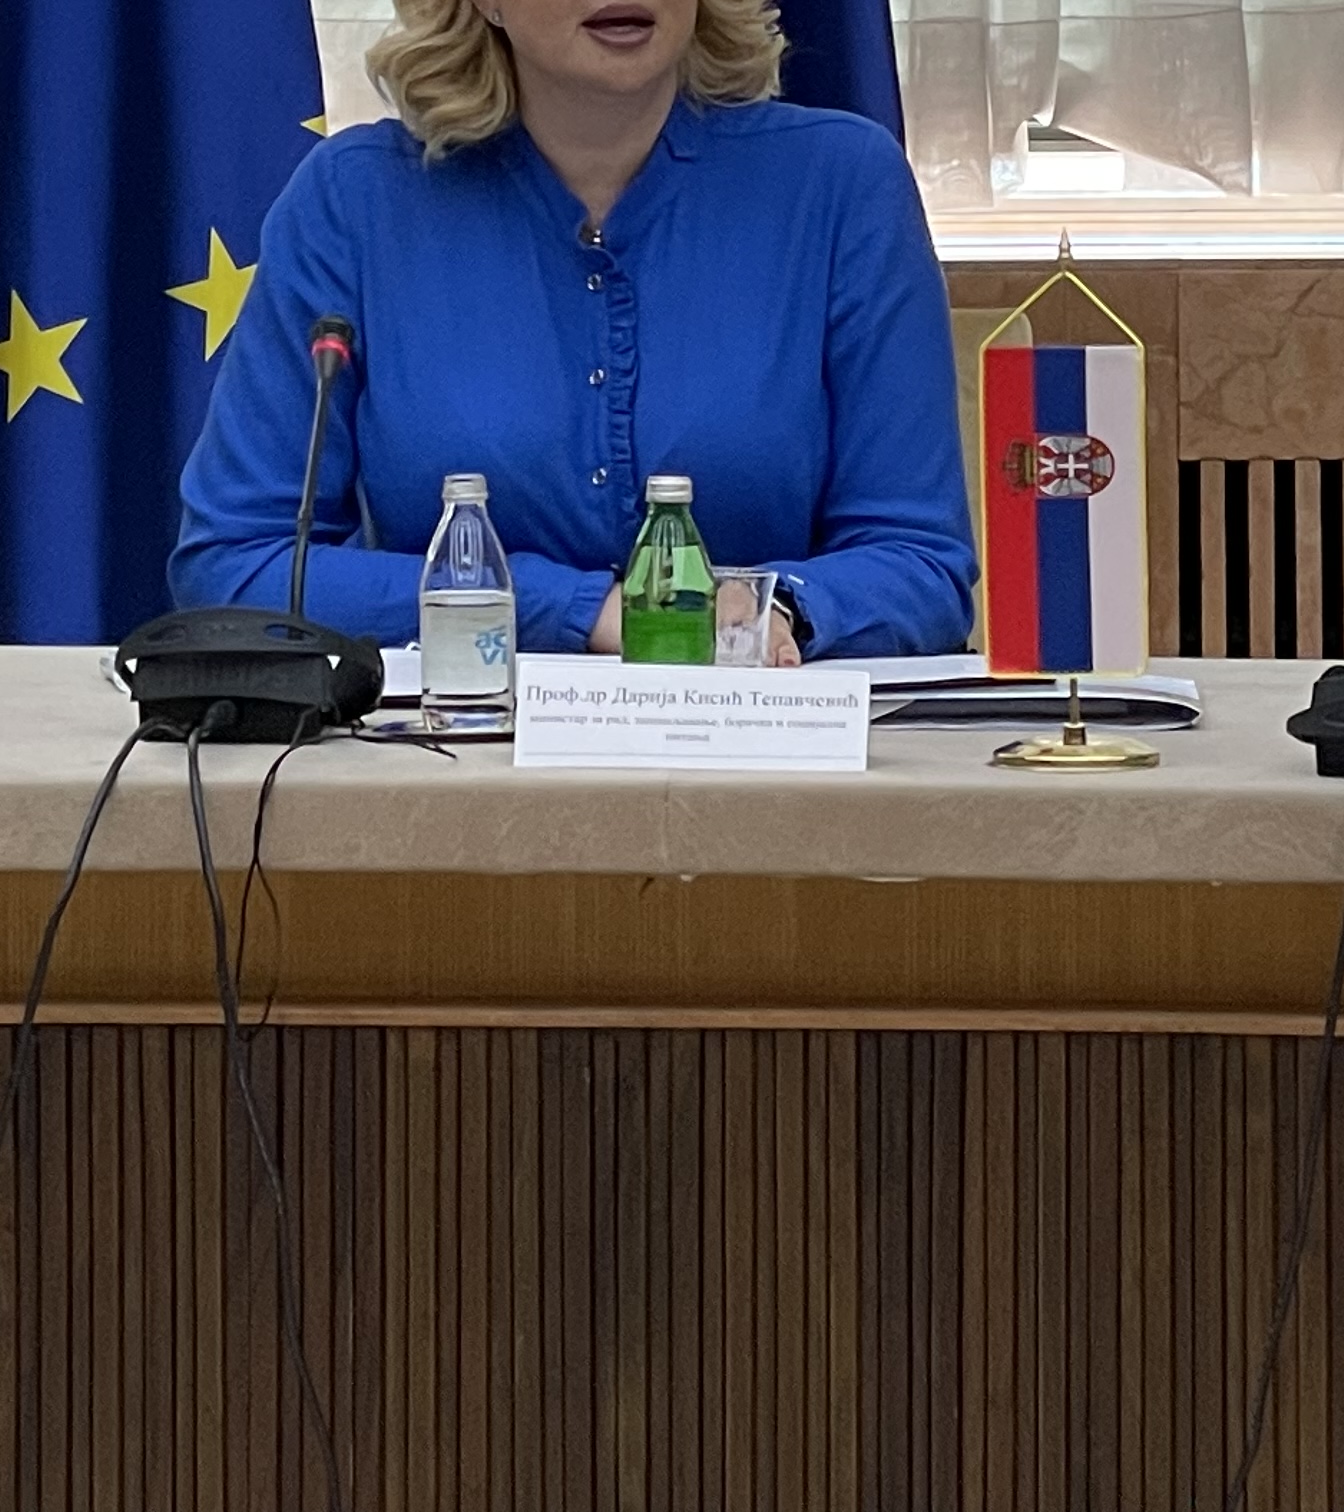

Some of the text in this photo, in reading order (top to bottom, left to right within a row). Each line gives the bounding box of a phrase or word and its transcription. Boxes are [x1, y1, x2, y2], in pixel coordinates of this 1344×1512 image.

[611, 688, 676, 708] Дарија
[685, 690, 742, 705] Кисић
[749, 692, 858, 707] Тепавчевић
